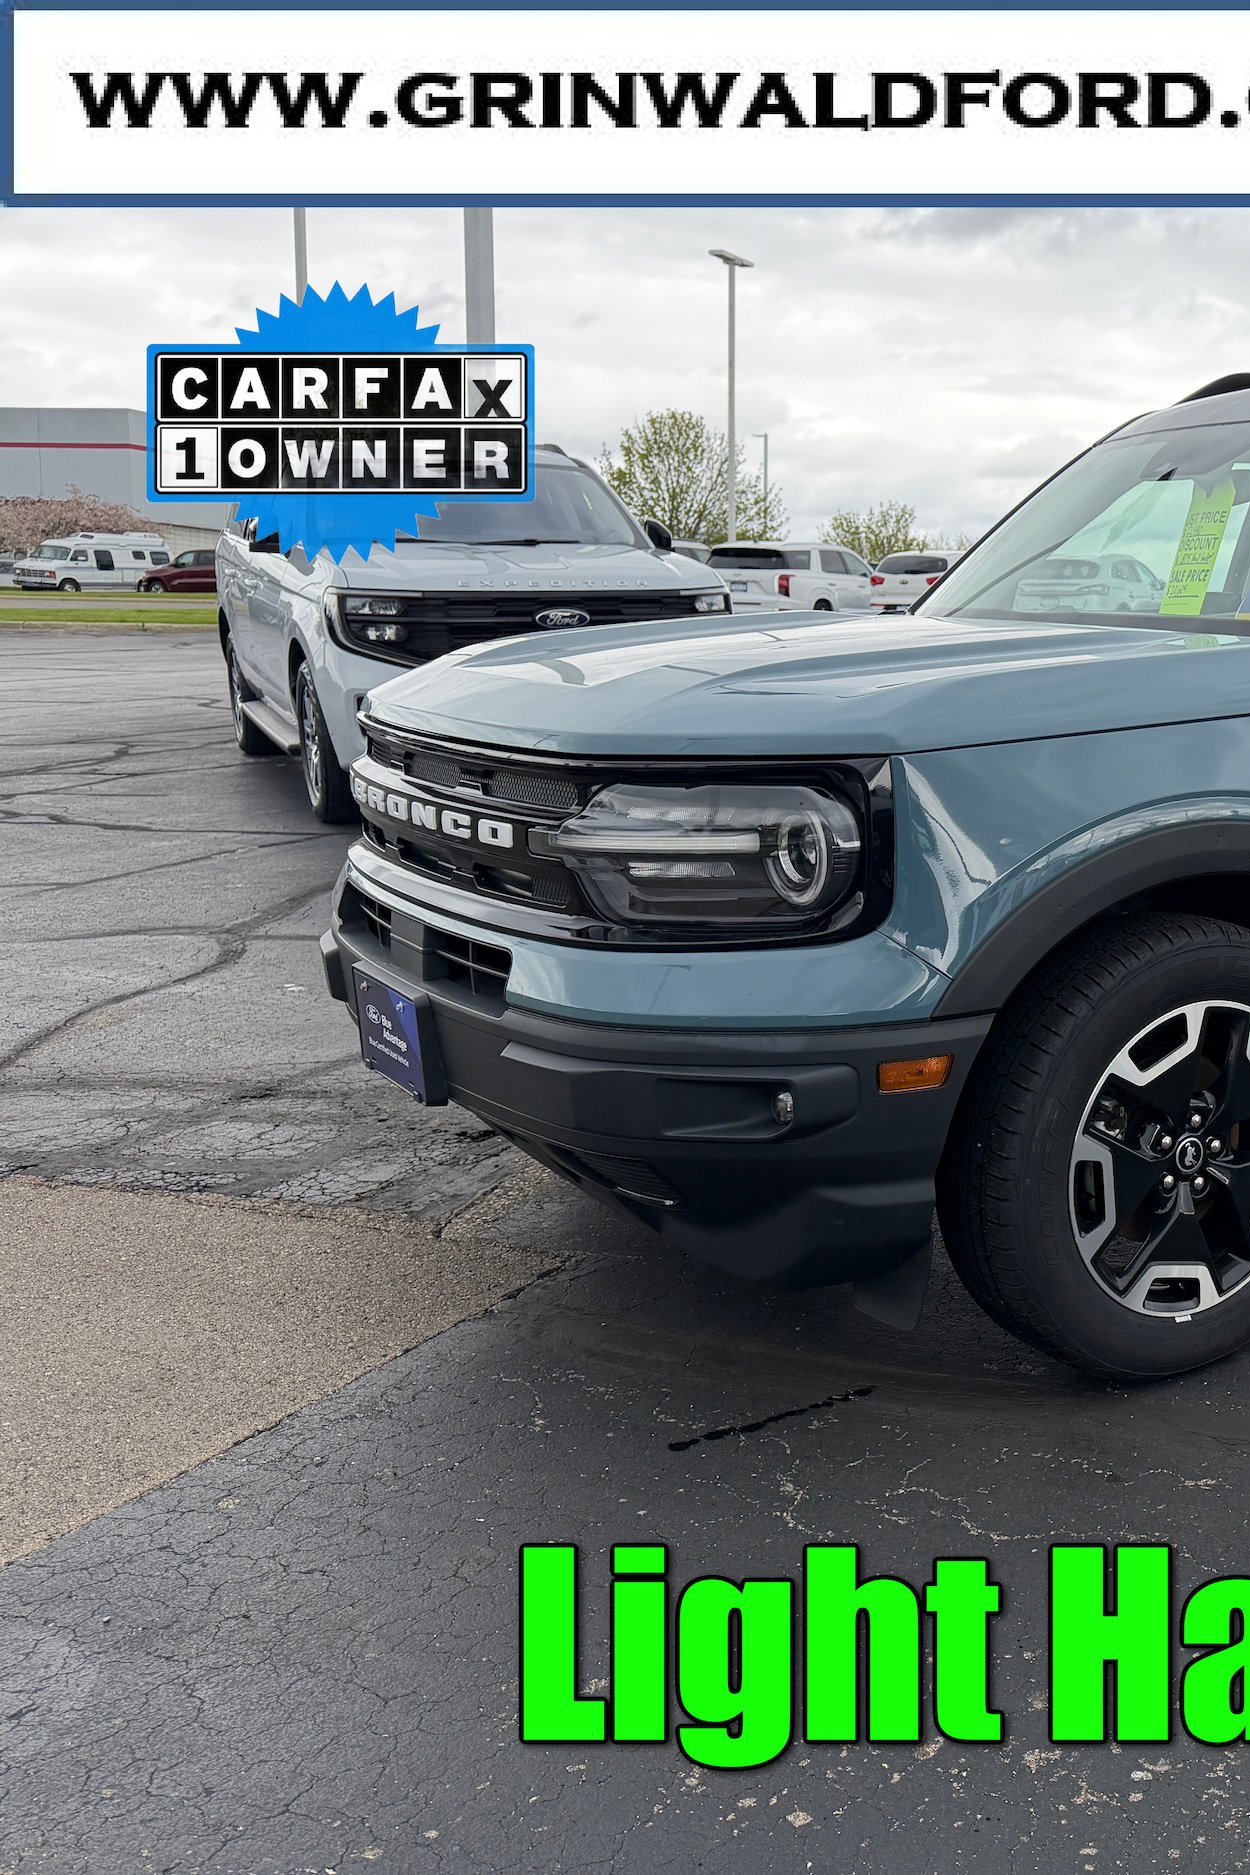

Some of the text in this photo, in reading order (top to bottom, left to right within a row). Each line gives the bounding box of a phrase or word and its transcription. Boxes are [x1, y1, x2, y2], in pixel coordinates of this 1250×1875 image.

[1200, 511, 1227, 524] PRICE
[1179, 537, 1219, 552] DISCOUNT
[1170, 569, 1210, 583] SALE PRICE
[457, 580, 649, 588] EXPEDITION
[353, 777, 514, 849] BRONCO
[381, 1014, 392, 1030] Blue
[383, 1028, 408, 1052] Advantage
